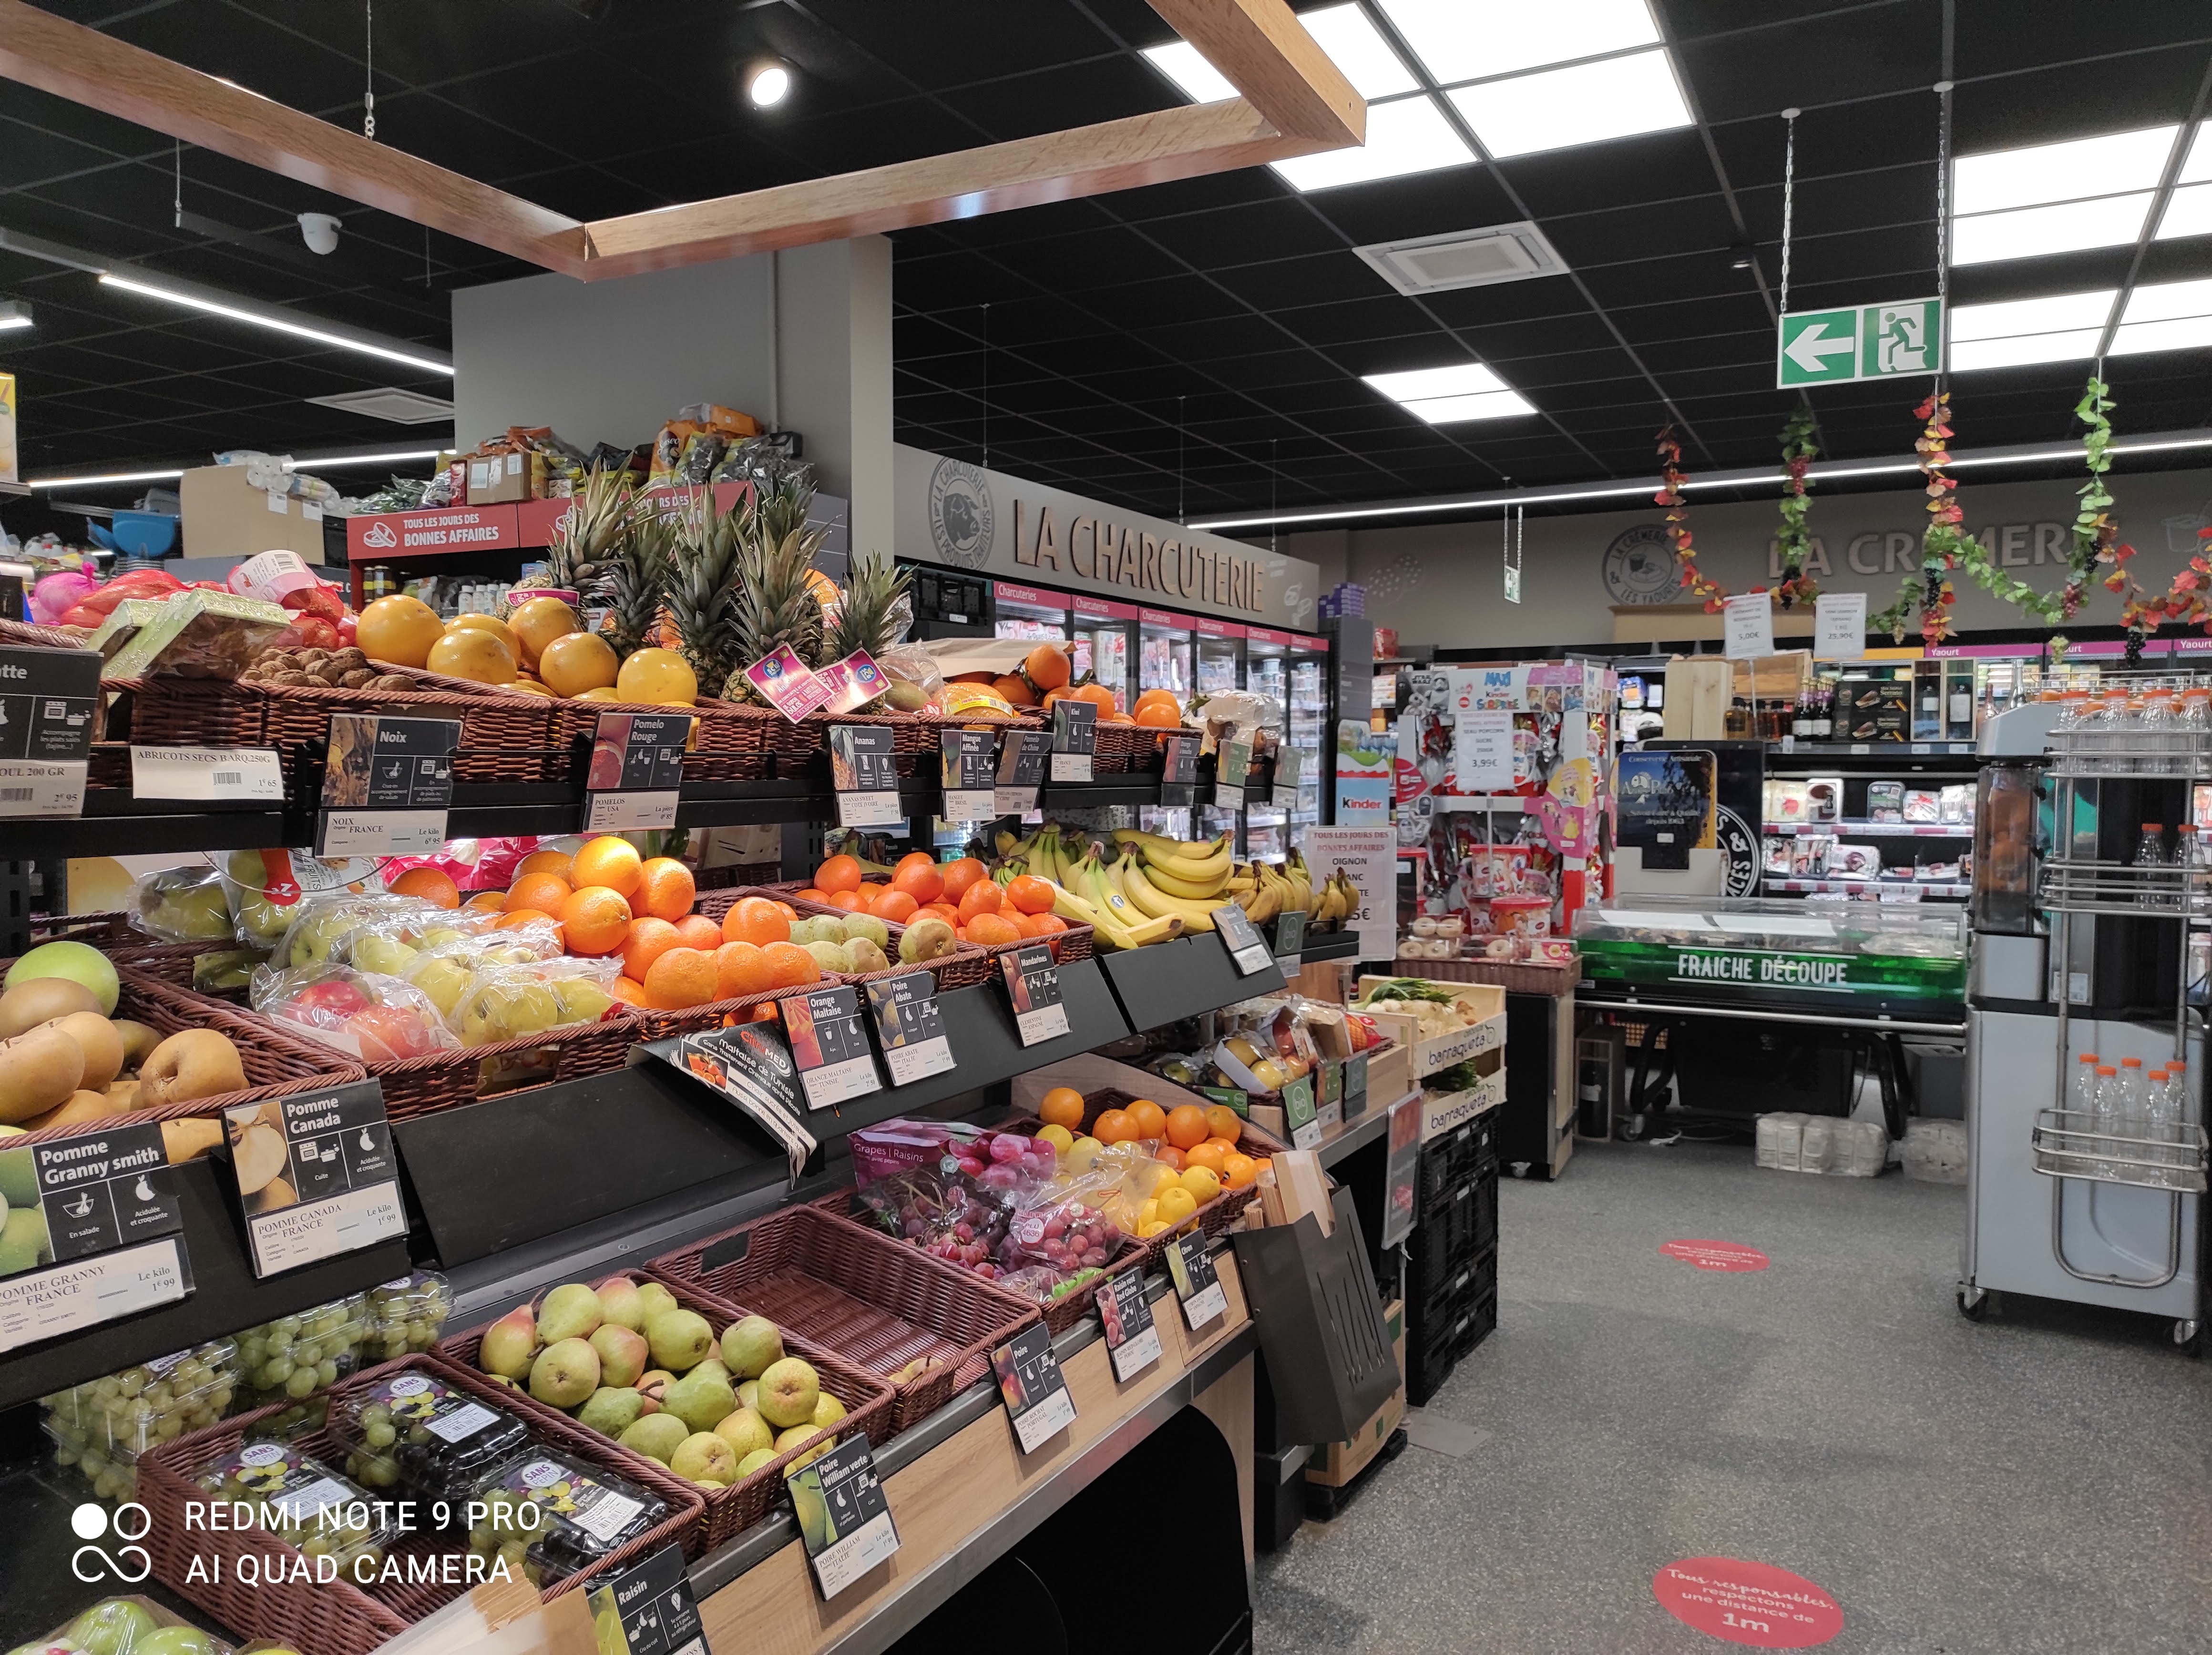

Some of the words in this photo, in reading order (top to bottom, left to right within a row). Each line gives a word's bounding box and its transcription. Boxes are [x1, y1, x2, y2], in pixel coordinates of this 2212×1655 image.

[404, 518, 424, 529] TOUS
[425, 517, 438, 527] LES
[439, 515, 463, 526] JOURS
[464, 513, 480, 524] DES
[404, 530, 447, 547] BONNES
[449, 526, 499, 543] AFFAIRES
[1014, 499, 1061, 572] LA
[1070, 515, 1265, 612] CHARCUTERIE
[999, 584, 1036, 602] Charcuteries
[1075, 598, 1109, 613] Charcuteries
[1932, 647, 1959, 657] Yaourt
[633, 719, 664, 729] Pomelo
[380, 731, 407, 743] Noix
[631, 731, 657, 744] Rouge
[854, 736, 876, 746] Ananas
[962, 734, 982, 744] Mangue
[962, 743, 980, 752] Affinée
[137, 751, 189, 760] ABRICOTS
[27, 768, 44, 776] 200
[305, 862, 321, 890] FRUITS
[1021, 955, 1047, 967] Mandarines
[1678, 954, 1753, 980] FRAICHE
[1760, 955, 1848, 984] DÉCOUPE
[891, 981, 909, 993] Poire
[810, 996, 835, 1009] Orange
[895, 991, 912, 1003] Abate
[813, 1006, 842, 1020] Maltaise
[891, 1052, 905, 1061] POIRE
[904, 1049, 919, 1057] ABATE
[1429, 1035, 1485, 1065] barraqueta
[901, 1056, 916, 1064] ITALIE
[703, 1039, 718, 1052] Sans
[719, 1047, 748, 1071] Traitement
[772, 1086, 785, 1101] après
[719, 1038, 757, 1067] Maltaise
[758, 1065, 769, 1077] de
[769, 1072, 794, 1100] Tunisie
[806, 1073, 829, 1083] ORANGE
[829, 1067, 852, 1079] MALTAISE
[819, 1078, 839, 1088] TUNISIE
[287, 1098, 339, 1117] Pomme
[747, 1081, 763, 1097] Chair
[764, 1096, 782, 1114] sucrée
[783, 1110, 789, 1120] et
[732, 1086, 748, 1103] Aussi
[748, 1097, 766, 1117] bonne
[766, 1114, 773, 1124] en
[773, 1118, 794, 1144] quartiers
[1431, 1094, 1486, 1129] barraqueta
[290, 1113, 341, 1134] Canada
[41, 1142, 108, 1166] Pomme
[854, 1144, 887, 1158] Grapes
[893, 1148, 924, 1163] Raisins
[44, 1158, 109, 1184] Granny
[113, 1147, 159, 1170] smith
[362, 1161, 386, 1172] croquante
[377, 1205, 391, 1214] kilo
[137, 1213, 168, 1225] croquante
[258, 1216, 298, 1235] POMME
[300, 1205, 342, 1222] CANADA
[78, 1226, 100, 1237] salade
[282, 1219, 324, 1238] FRANCE
[1181, 1245, 1193, 1256] Citron
[51, 1265, 107, 1287] GRANNY
[139, 1271, 151, 1281] Le
[153, 1267, 170, 1278] kilo
[1114, 1280, 1126, 1292] Raisin
[1125, 1285, 1137, 1298] Globe
[26, 1284, 82, 1306] FRANCE
[1014, 1346, 1028, 1359] Poire
[393, 1378, 420, 1391] SANS
[1027, 1412, 1047, 1429] PORTUGAL
[244, 1445, 274, 1459] SANS
[524, 1464, 550, 1481] SANS
[819, 1458, 839, 1476] Poire
[822, 1467, 850, 1488] William
[848, 1454, 868, 1474] verte
[819, 1551, 837, 1568] POIRE
[836, 1536, 860, 1556] WILLIAM
[833, 1552, 850, 1567] ITALIE
[1667, 1569, 1709, 1584] Tous
[618, 1580, 648, 1606] Raisin
[1702, 1587, 1795, 1610] respectons
[1682, 1592, 1713, 1604] une
[1717, 1598, 1789, 1618] distance
[1792, 1614, 1814, 1624] de
[1722, 1613, 1770, 1633] 1m
